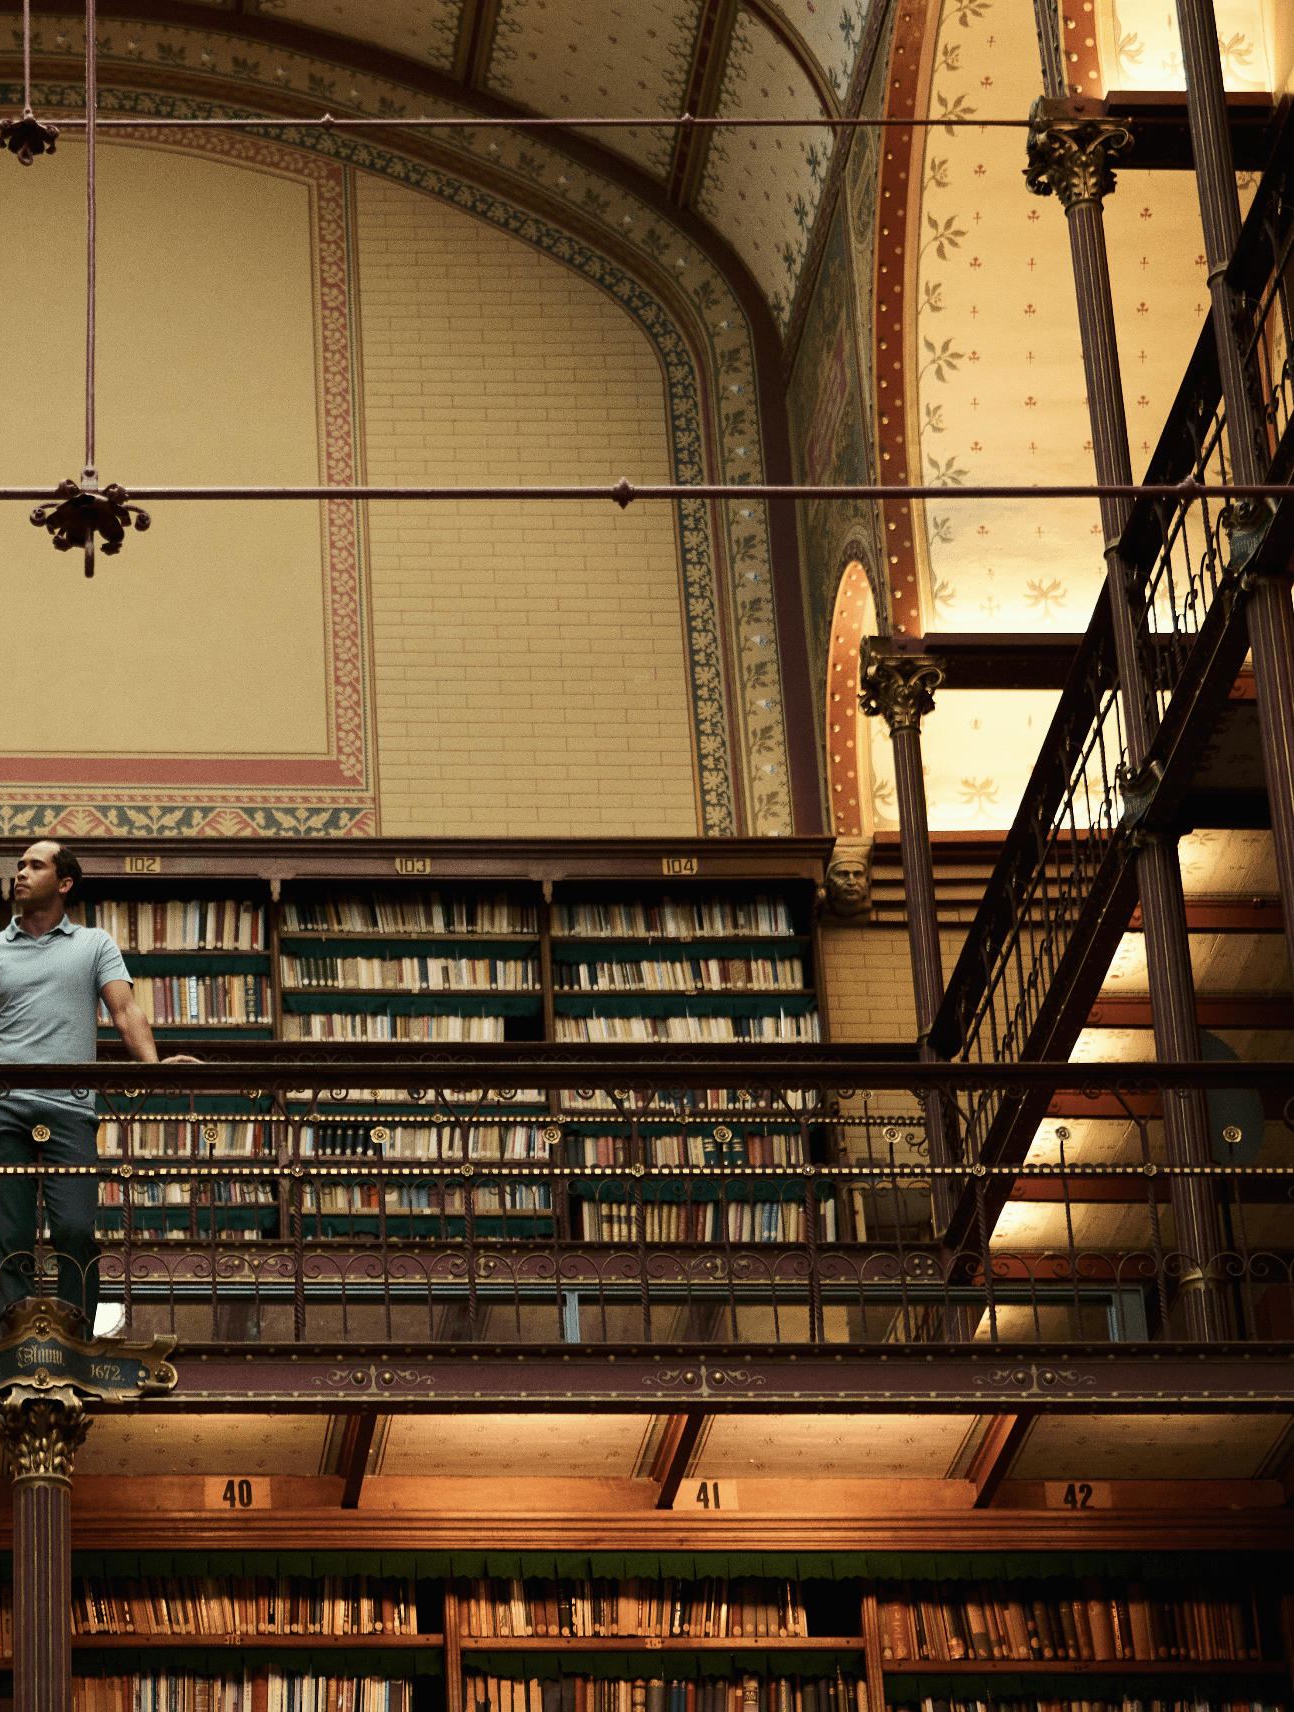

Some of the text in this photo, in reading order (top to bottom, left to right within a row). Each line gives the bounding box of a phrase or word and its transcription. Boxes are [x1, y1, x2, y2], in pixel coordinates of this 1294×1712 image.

[130, 857, 156, 872] 102
[399, 859, 426, 873] 103
[667, 859, 694, 874] 104
[223, 1479, 252, 1508] 40
[696, 1481, 721, 1509] 41
[1064, 1483, 1094, 1509] 42
